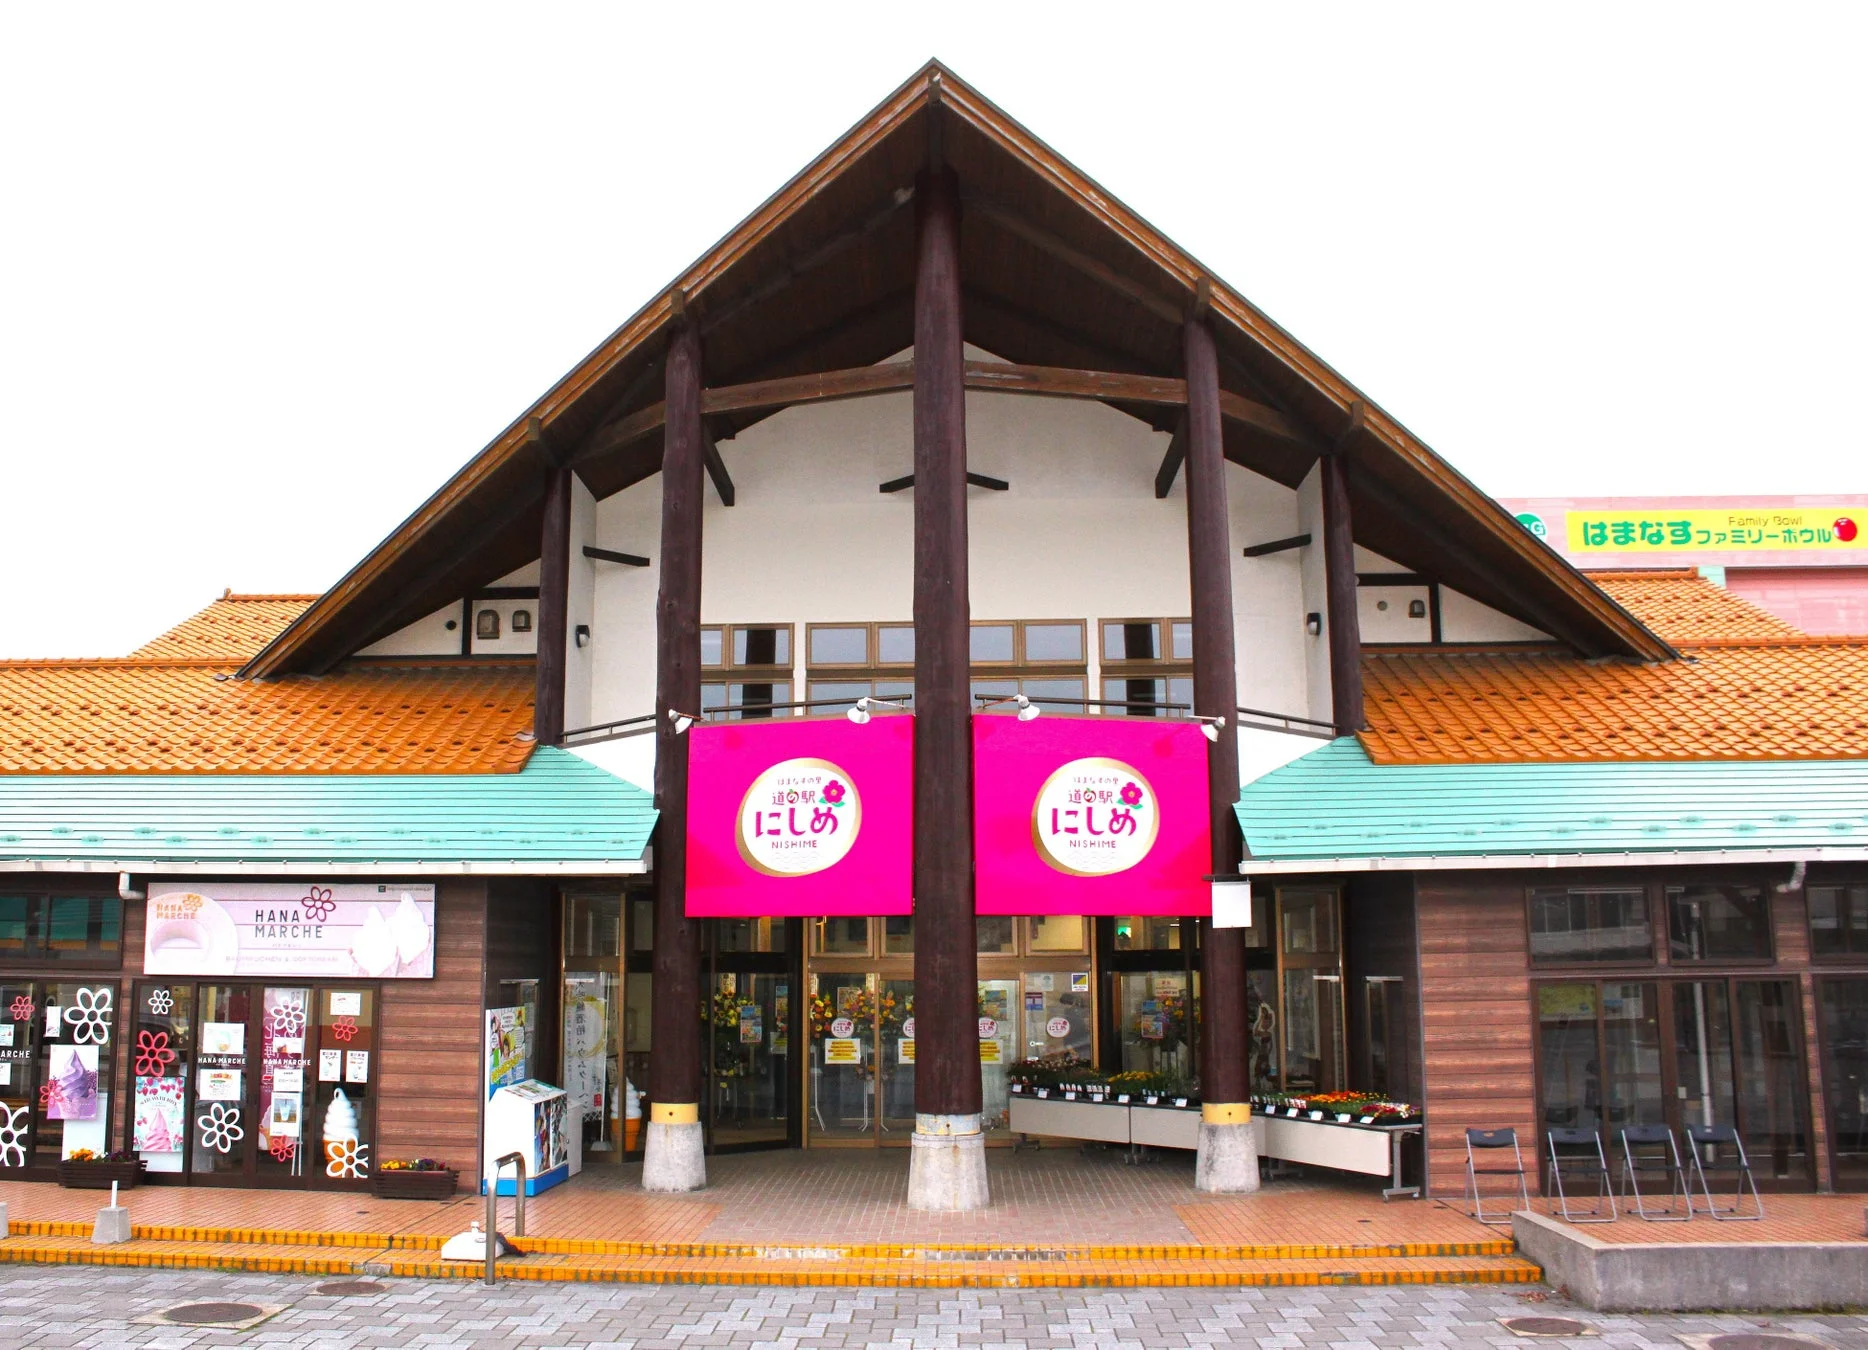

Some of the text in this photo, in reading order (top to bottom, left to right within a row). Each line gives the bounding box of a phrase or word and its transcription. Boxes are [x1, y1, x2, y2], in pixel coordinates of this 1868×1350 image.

[1728, 516, 1803, 527] Family Bowl
[1583, 521, 1692, 546] はまなす
[772, 788, 816, 806] 道の駅
[1068, 788, 1114, 804] 道の駅
[755, 807, 838, 838] にしめ
[1051, 806, 1137, 837] にしめ
[771, 840, 818, 849] NISHIME
[1069, 840, 1117, 849] NISHIME
[156, 903, 183, 911] HANA
[156, 912, 196, 920] MARCHE
[255, 909, 300, 922] HANA
[255, 925, 323, 938] MARCHE
[0, 1050, 31, 1058] ARCHE
[218, 1057, 246, 1065] MARCHE
